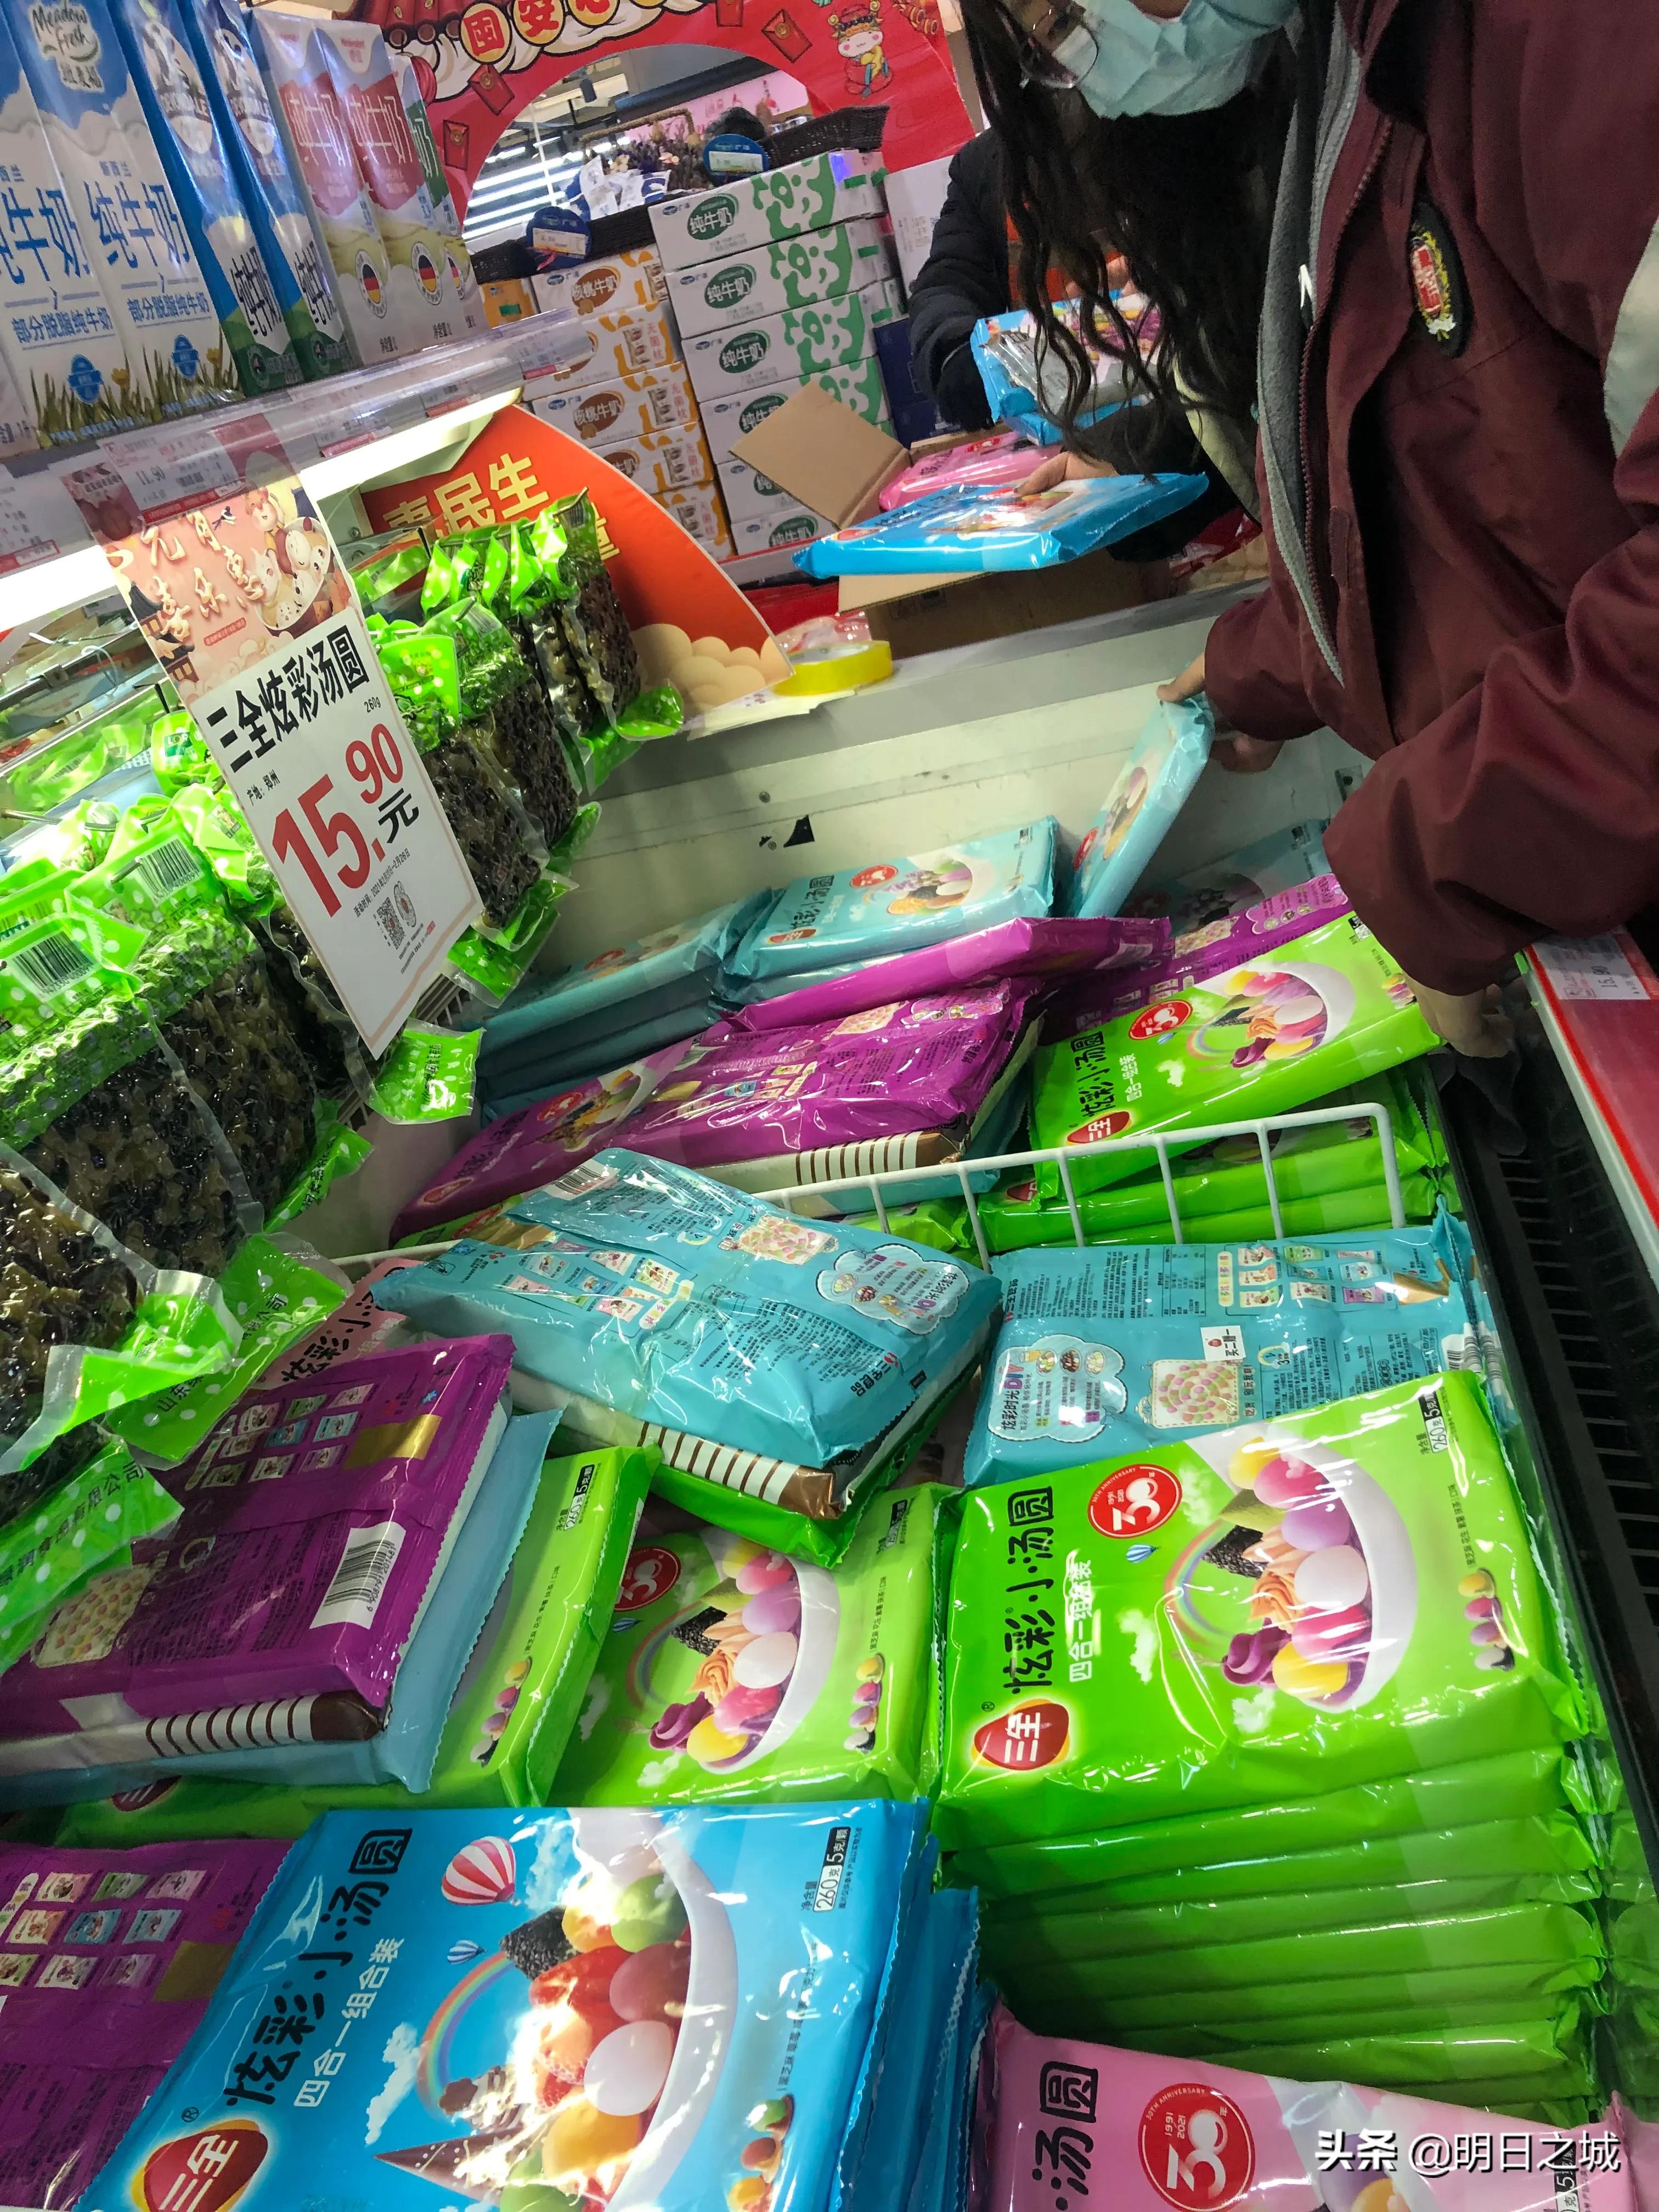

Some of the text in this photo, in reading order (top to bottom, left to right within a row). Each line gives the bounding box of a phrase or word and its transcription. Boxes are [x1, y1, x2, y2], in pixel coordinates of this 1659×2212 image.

[83, 181, 190, 269] 纯牛奶
[690, 206, 735, 235] 纯牛奶
[707, 276, 752, 303] 纯牛奶
[721, 342, 765, 368] 纯牛奶
[206, 623, 370, 774] 三全炫彩汤圆
[363, 695, 381, 714] 260g
[378, 787, 420, 844] 元
[1070, 1031, 1116, 1118] 炫彩小汤圆
[1088, 1118, 1111, 1142] 三全
[850, 1359, 892, 1397] 三全食品
[1002, 1364, 1024, 1431] 炫彩时光 DIY
[1432, 1418, 1448, 1452] 260克
[1003, 1486, 1054, 1695] 炫彩小汤圆
[1068, 1558, 1094, 1684] 四合一组合装
[1003, 1711, 1042, 1764] 三全
[800, 1880, 817, 1911] 净含量
[815, 1827, 850, 1911] 260克 5克/颗
[222, 1827, 413, 2107] 炫彩小汤圆
[292, 1937, 405, 2108] 四合一组合装
[1146, 2087, 1208, 2121] 30TH ANNIVERSARY
[1165, 2111, 1176, 2137] 1991
[1176, 2112, 1186, 2140] 2021
[159, 2133, 239, 2212] 三全
